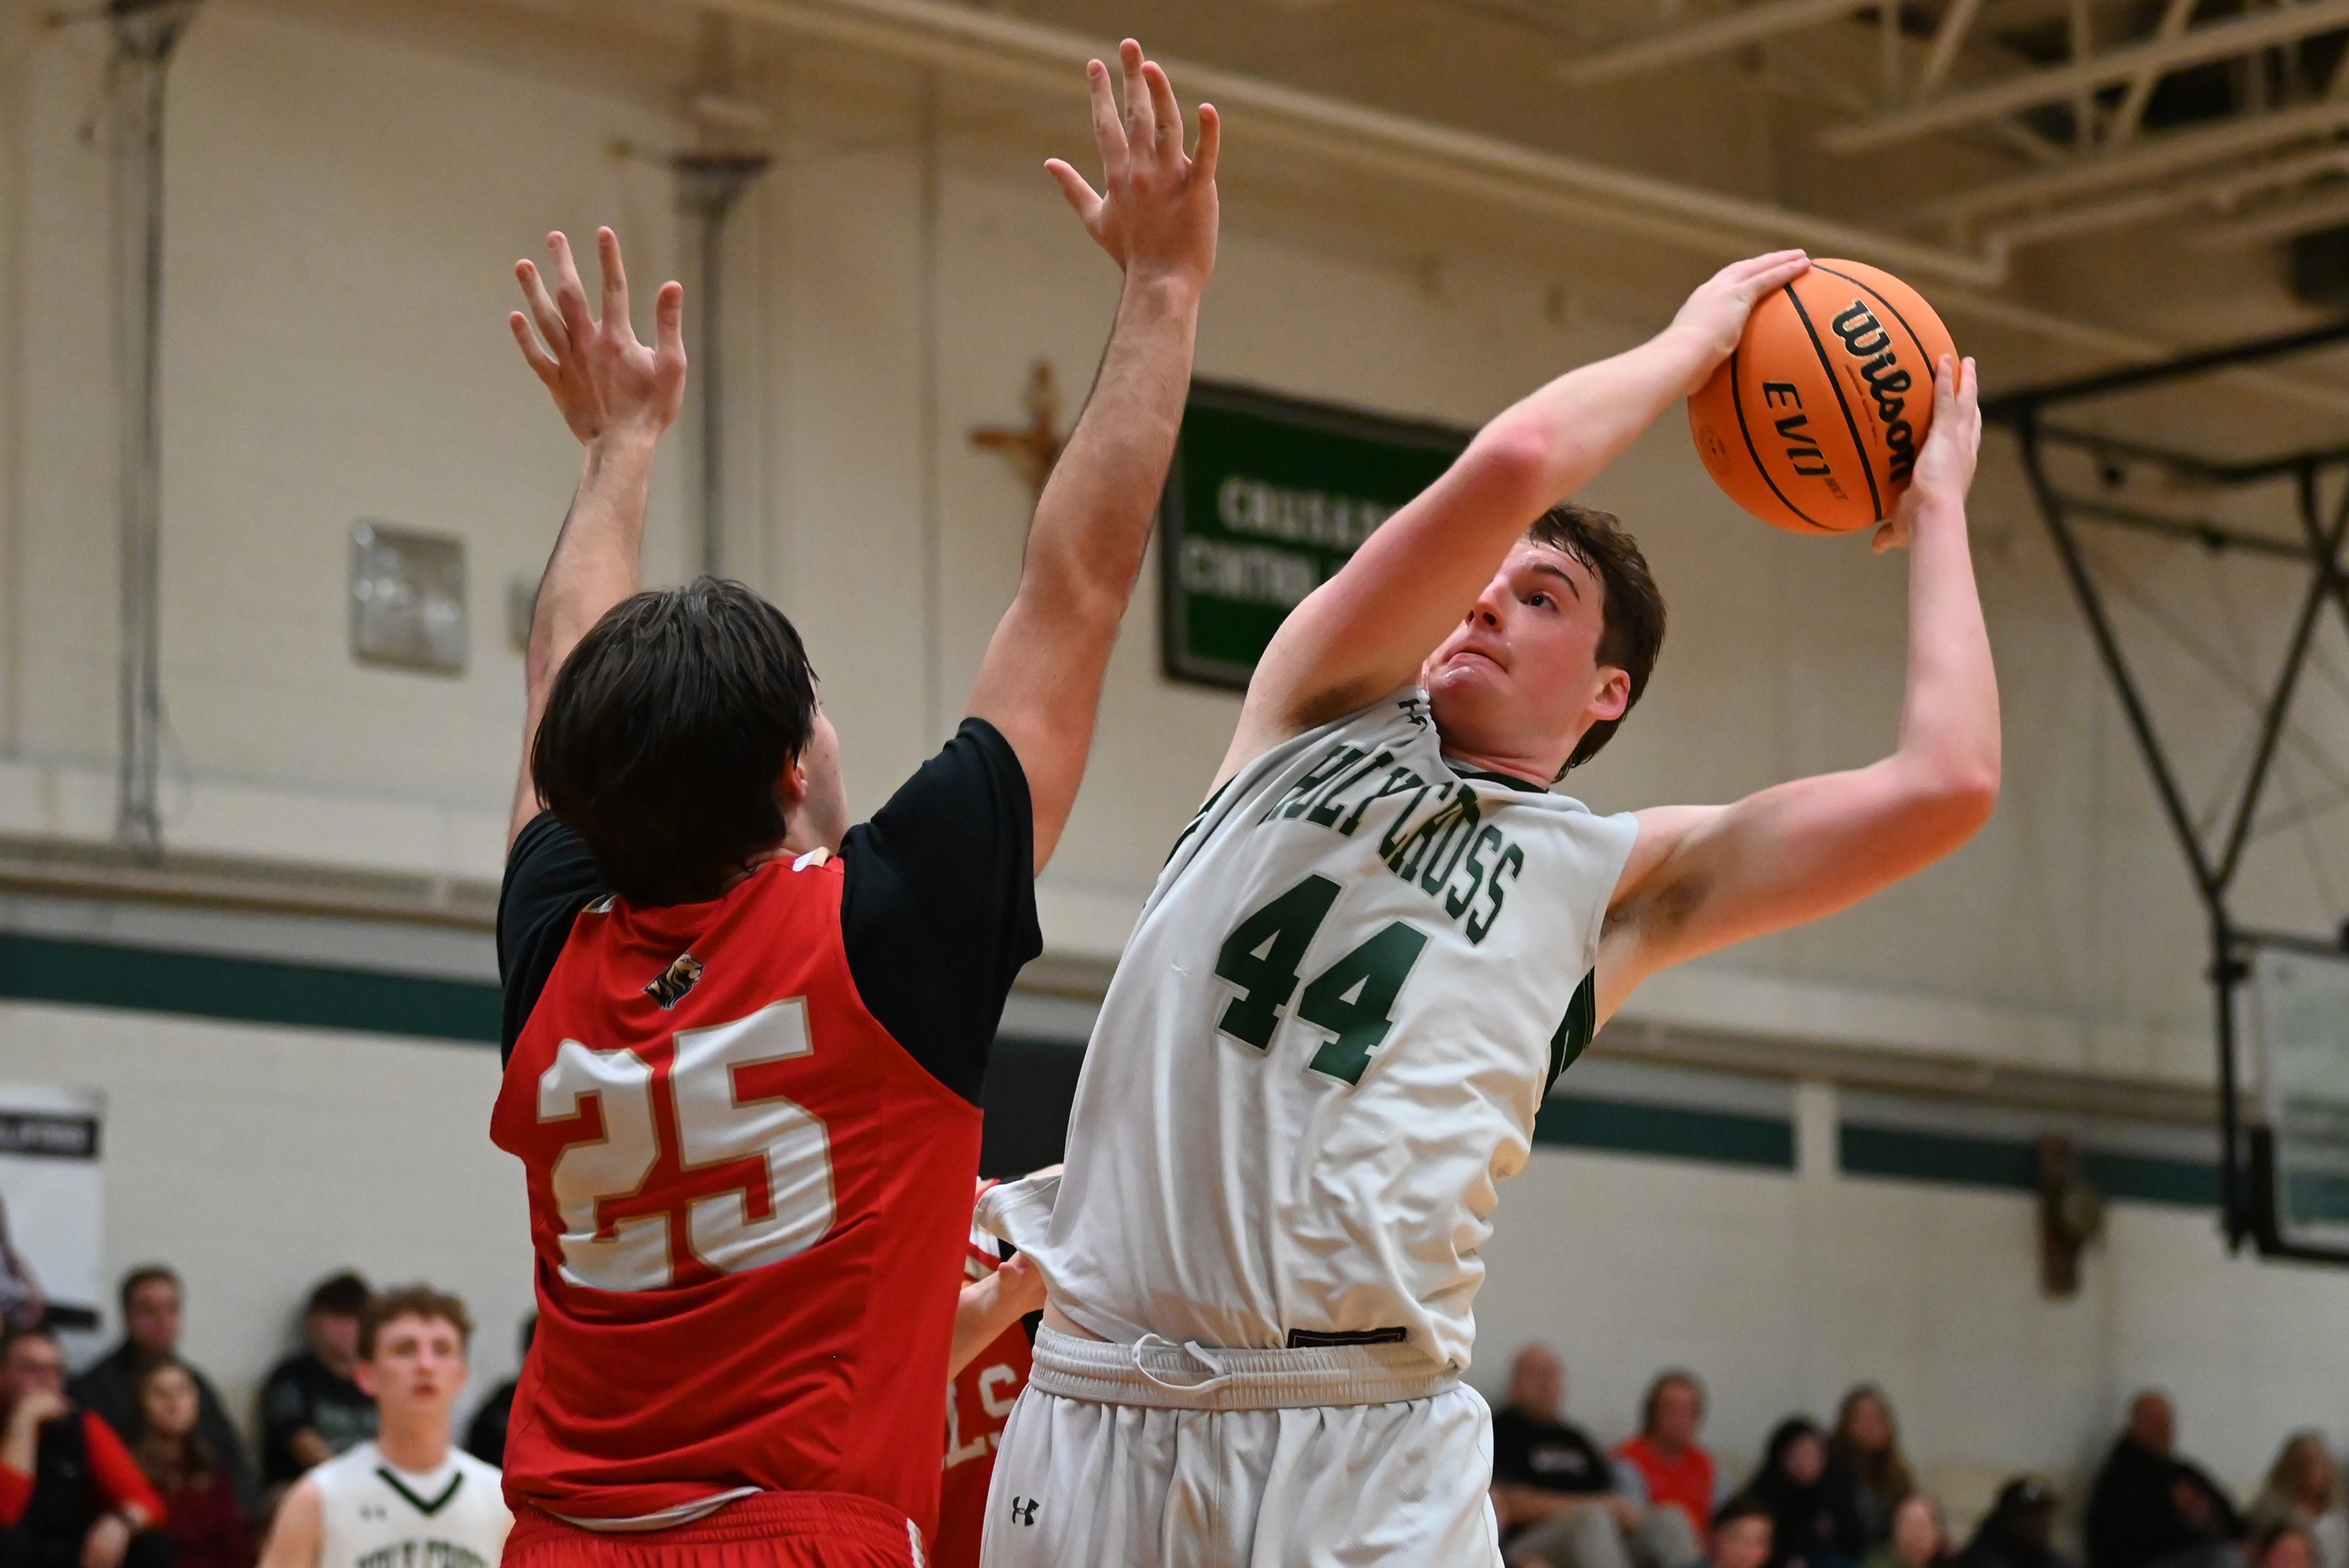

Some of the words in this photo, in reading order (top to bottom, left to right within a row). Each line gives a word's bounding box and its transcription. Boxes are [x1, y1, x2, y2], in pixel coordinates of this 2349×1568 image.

[1763, 380, 1831, 476] EVO
[1831, 299, 1916, 484] Wilson
[1378, 780, 1525, 947] CROSS
[1214, 873, 1434, 1089] 44
[537, 996, 838, 1292] 25
